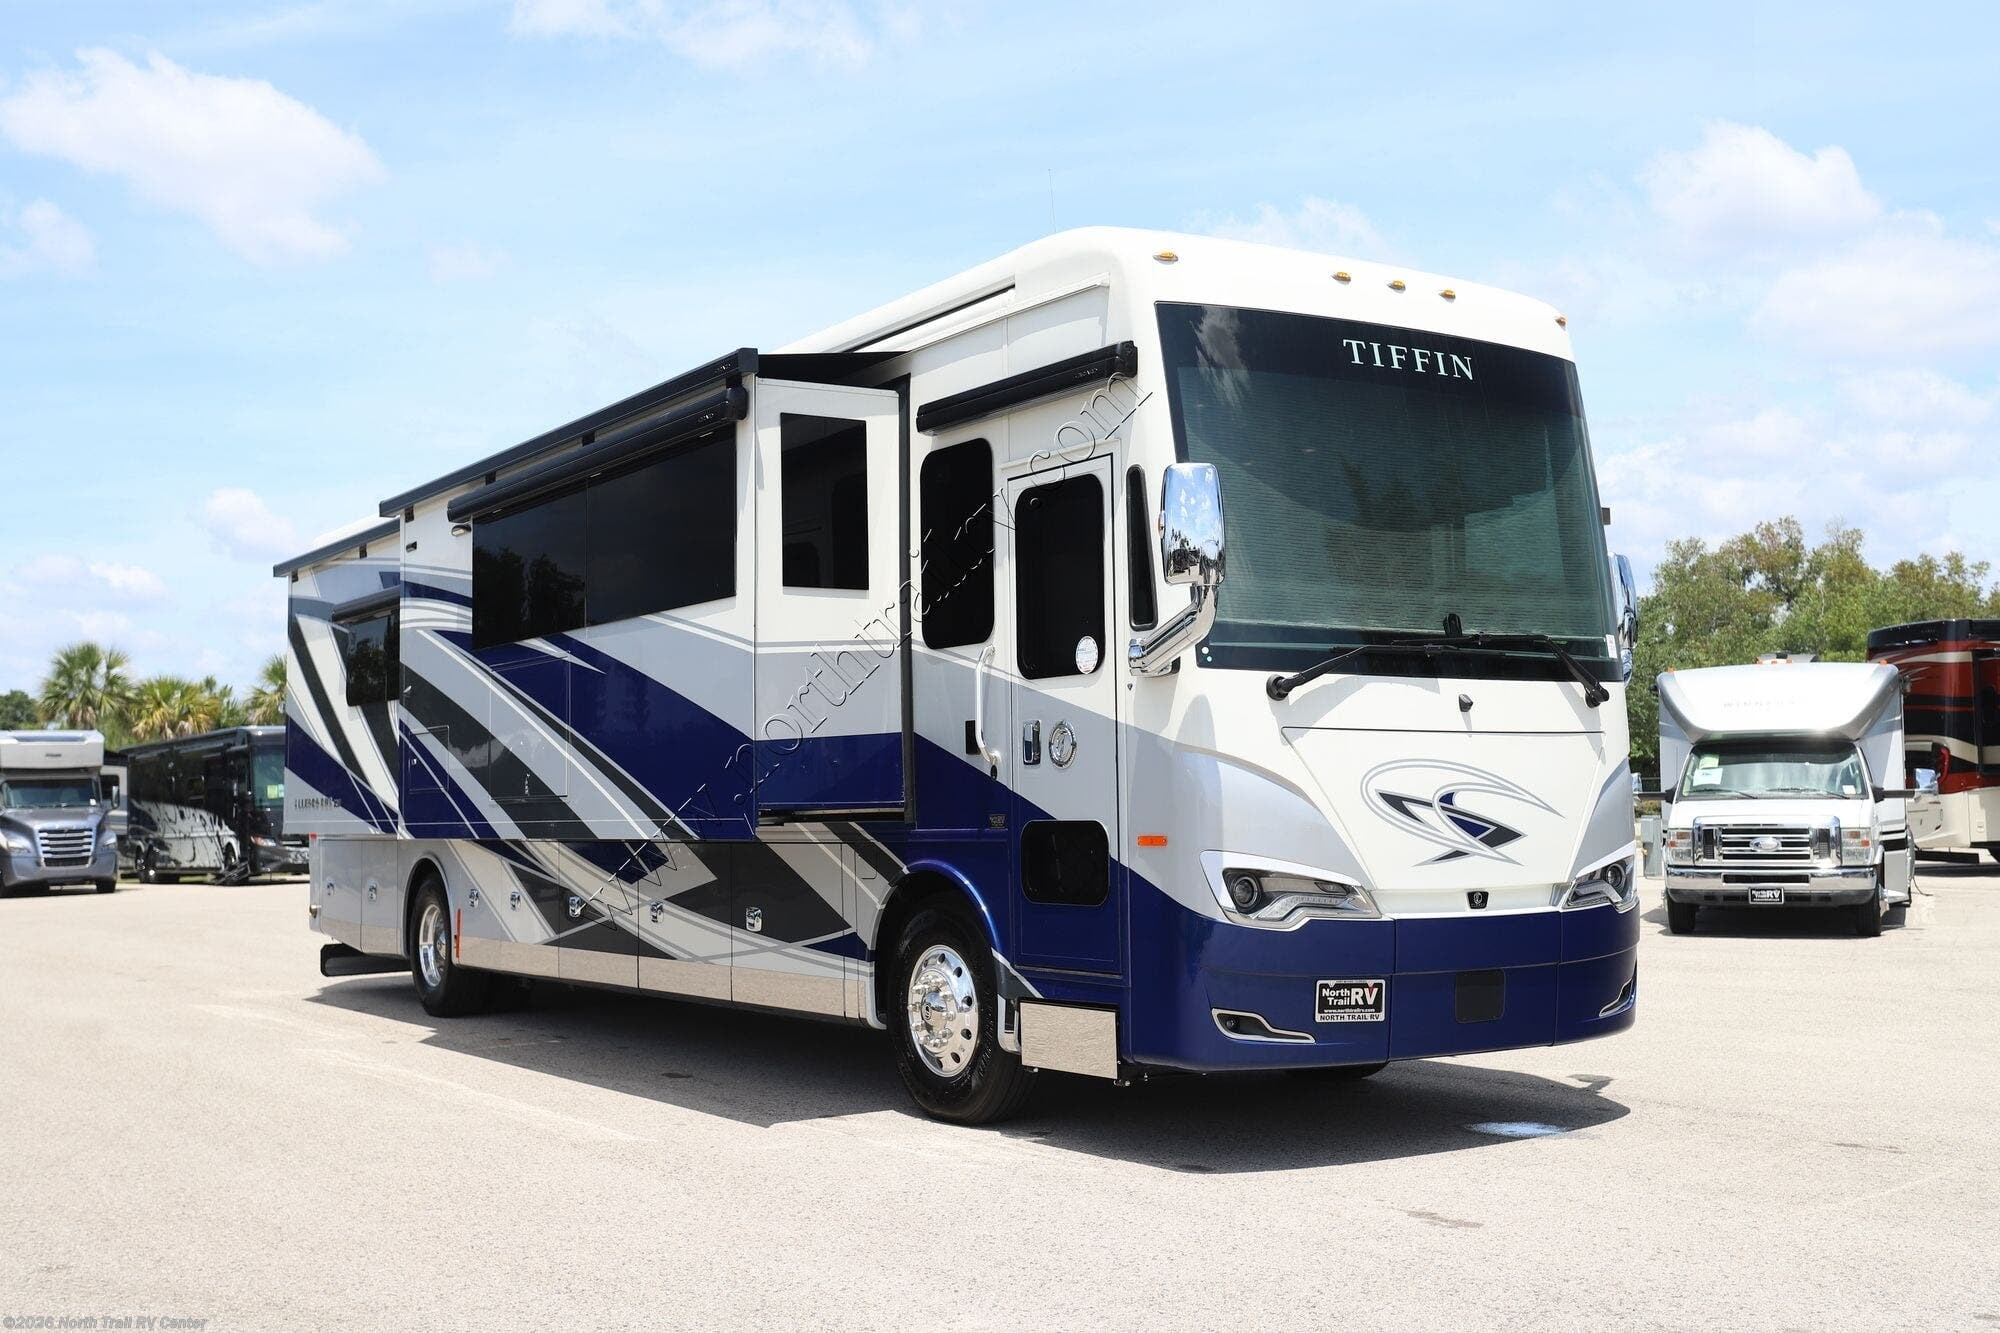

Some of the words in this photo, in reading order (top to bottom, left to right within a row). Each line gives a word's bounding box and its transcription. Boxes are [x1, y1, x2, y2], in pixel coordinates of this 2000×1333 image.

[1342, 338, 1474, 381] TIFFIN
[1322, 988, 1350, 997] North
[1351, 987, 1379, 1005] RV
[1327, 997, 1350, 1006] Trail
